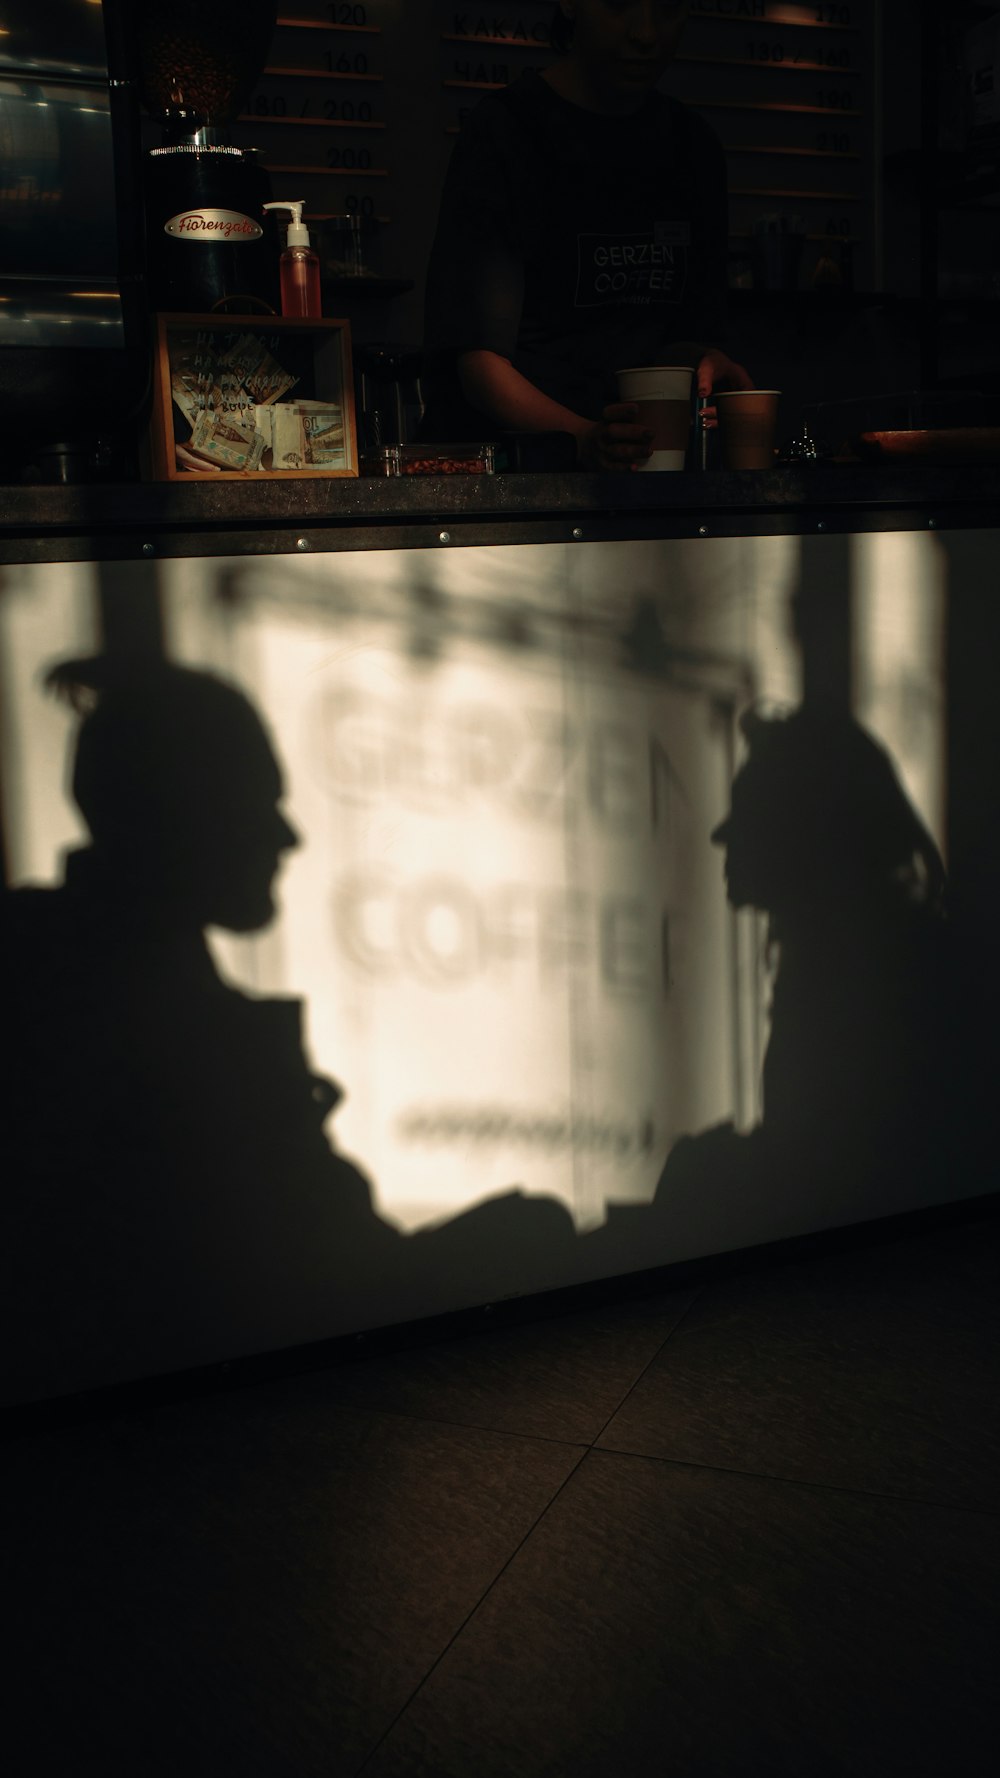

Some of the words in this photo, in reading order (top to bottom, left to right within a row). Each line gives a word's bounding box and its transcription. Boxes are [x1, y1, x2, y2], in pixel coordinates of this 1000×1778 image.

[327, 4, 367, 26] 120
[323, 50, 368, 73] 160
[323, 99, 372, 121] 200
[327, 147, 370, 168] 200
[179, 215, 254, 238] Fiorenzato
[593, 244, 675, 267] GERZEN
[594, 269, 675, 293] COFFEE
